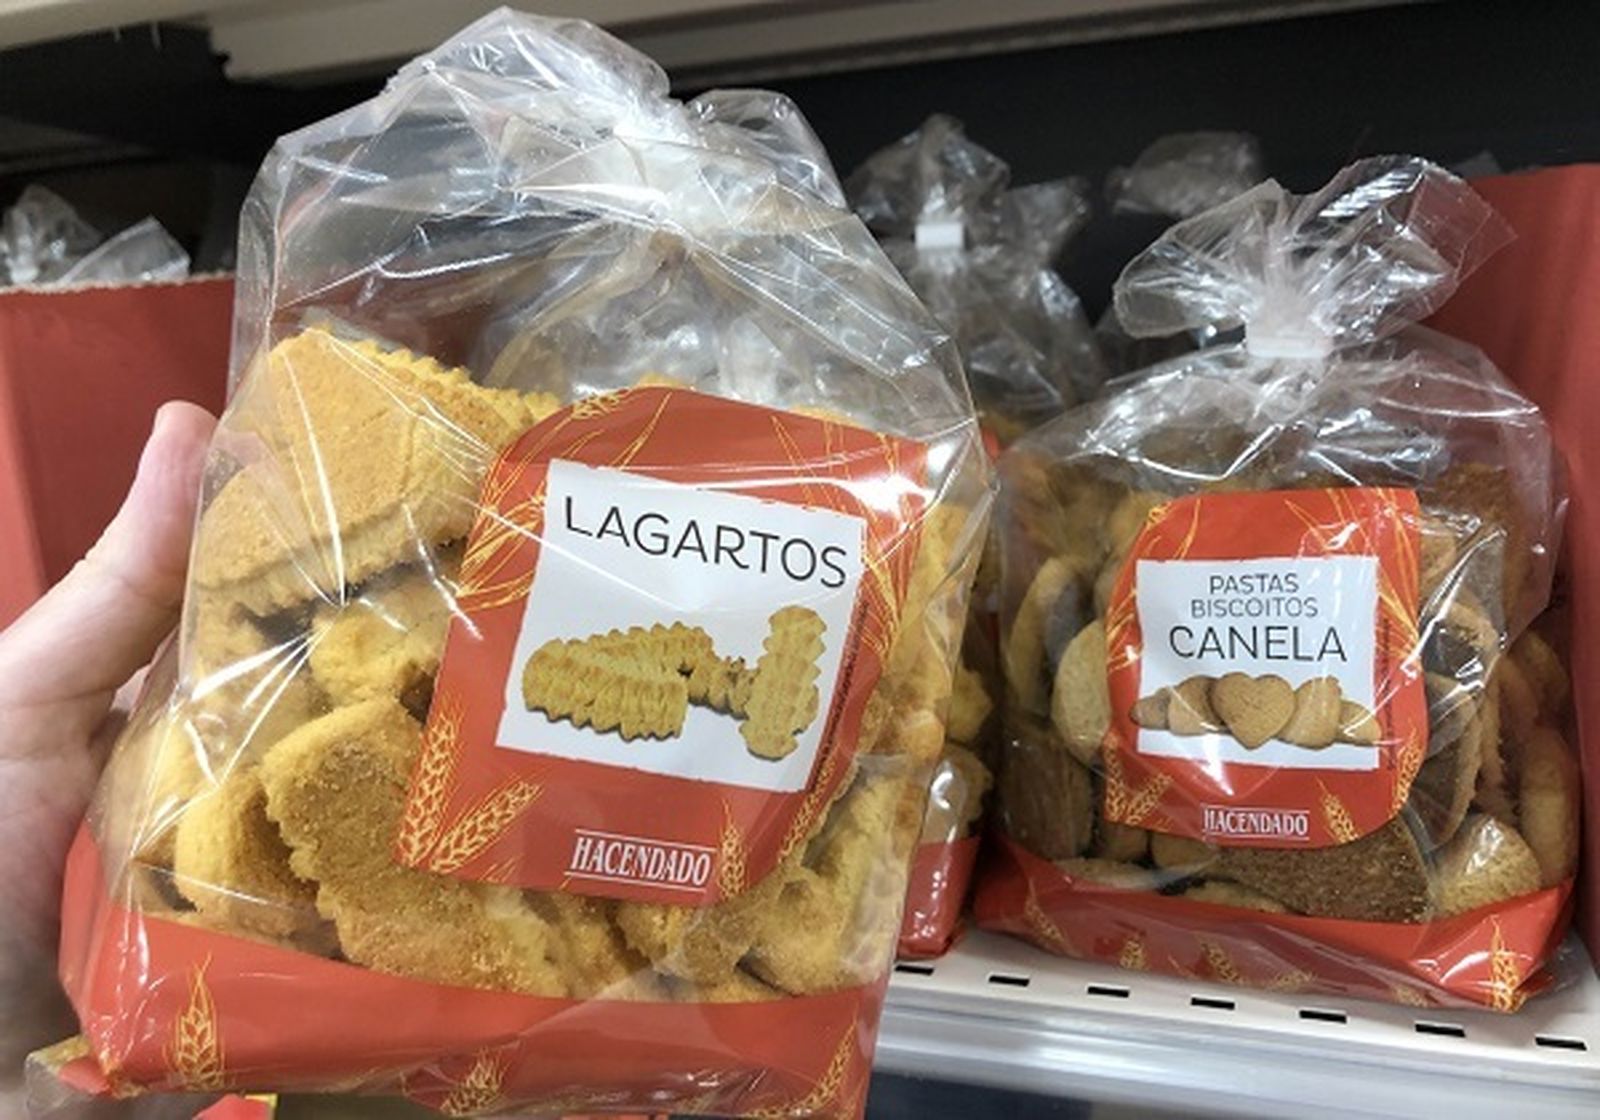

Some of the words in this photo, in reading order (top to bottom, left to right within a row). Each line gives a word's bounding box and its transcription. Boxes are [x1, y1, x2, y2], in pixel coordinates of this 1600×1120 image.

[564, 495, 848, 589] LAGARTOS
[1208, 572, 1300, 595] PASTAS
[1190, 596, 1319, 619] BISCOITOS
[1168, 625, 1348, 662] CANELA
[1203, 809, 1309, 837] HACENDADO
[569, 836, 712, 886] HACENDADO
